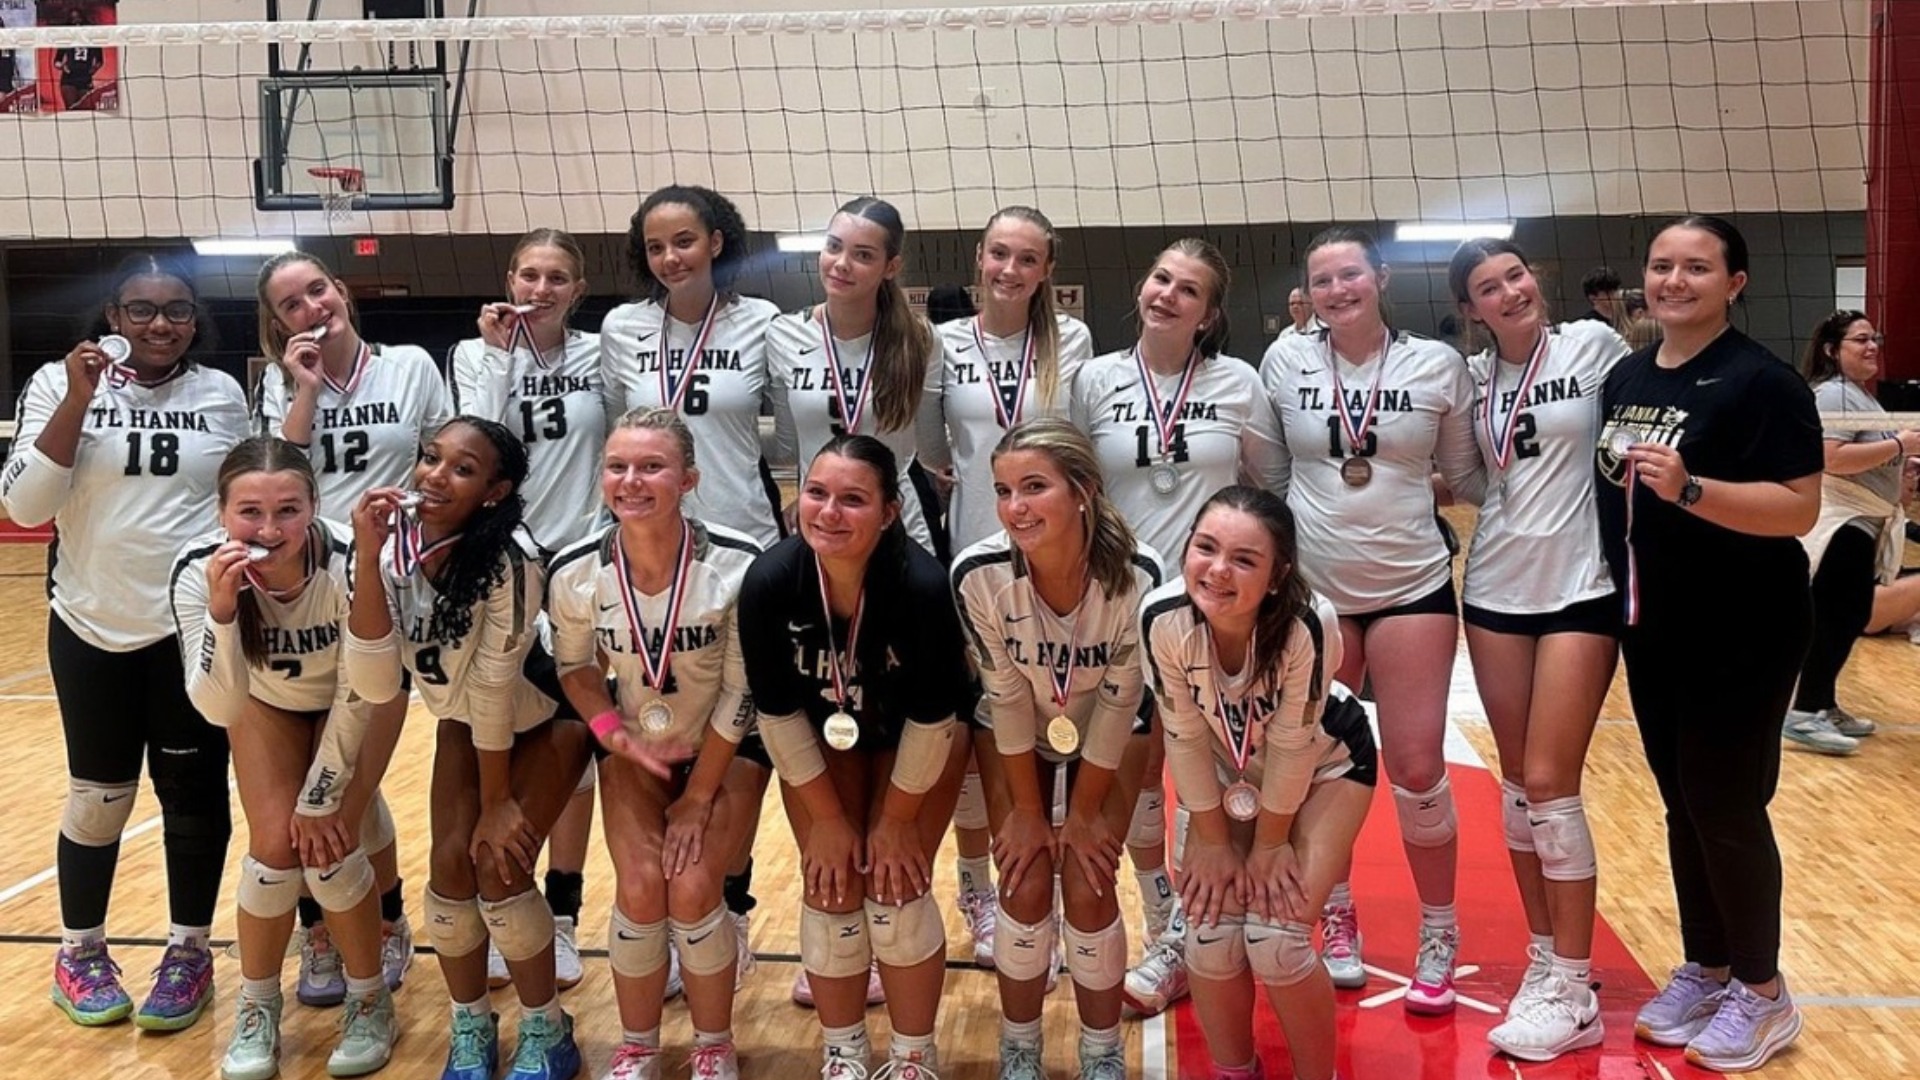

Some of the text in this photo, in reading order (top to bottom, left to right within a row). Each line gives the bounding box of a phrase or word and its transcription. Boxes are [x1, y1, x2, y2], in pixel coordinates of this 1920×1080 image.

[636, 348, 743, 374] TL HNNA
[954, 363, 981, 385] TL
[522, 375, 592, 398] HANNA
[791, 367, 815, 391] TL
[1112, 403, 1137, 423] TL
[1298, 388, 1323, 411] TL
[92, 407, 212, 434] TL HANNA
[322, 402, 400, 430] HANNA
[519, 397, 568, 443] 13
[1135, 423, 1189, 468] 14
[1327, 415, 1378, 459] 15
[1513, 413, 1541, 461] 2
[124, 431, 180, 477] 18
[320, 430, 369, 474] 12
[263, 620, 339, 655] HANNA
[416, 645, 449, 685] 9
[1037, 641, 1108, 668] HANN
